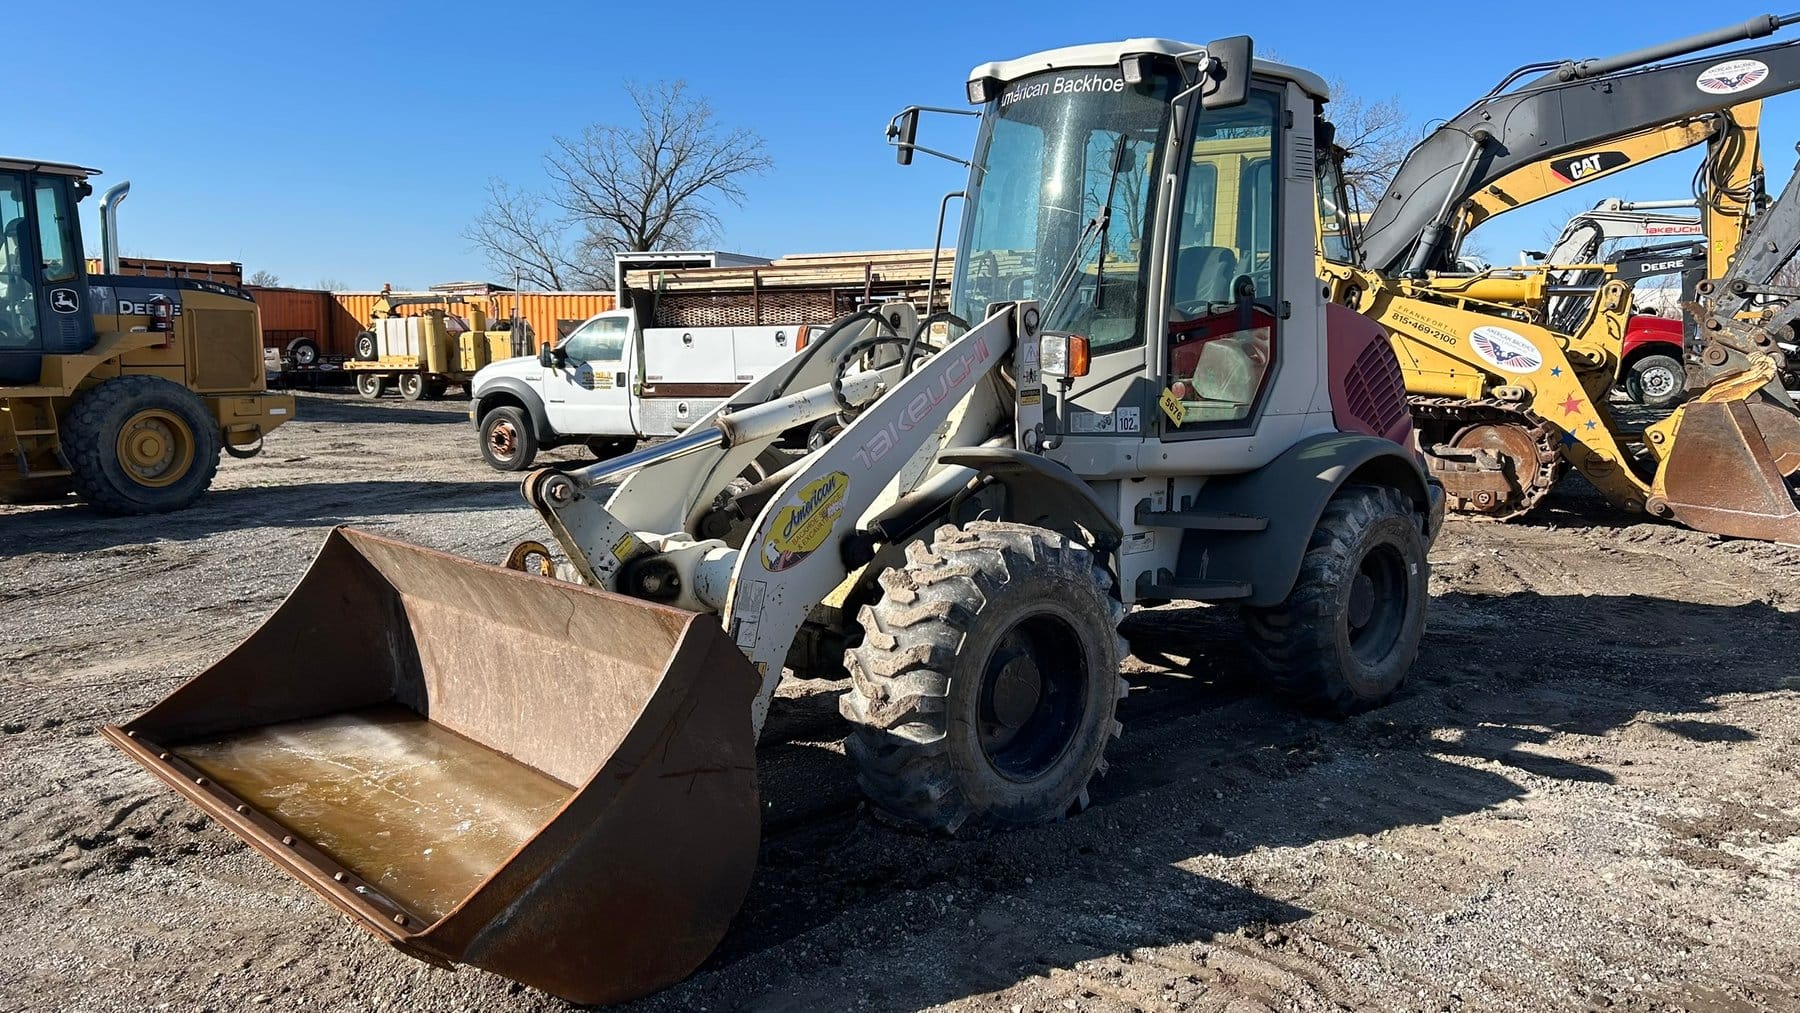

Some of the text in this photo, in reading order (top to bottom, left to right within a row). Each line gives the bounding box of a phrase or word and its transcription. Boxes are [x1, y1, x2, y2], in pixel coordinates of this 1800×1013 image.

[1053, 74, 1124, 94] Backhoe
[1570, 154, 1602, 180] CAT
[1641, 260, 1684, 273] DEERE
[119, 301, 181, 315] DEEE
[1164, 398, 1182, 422] 5676
[1119, 417, 1134, 431] 102
[783, 476, 836, 537] American
[791, 517, 820, 546] BACKHOE
